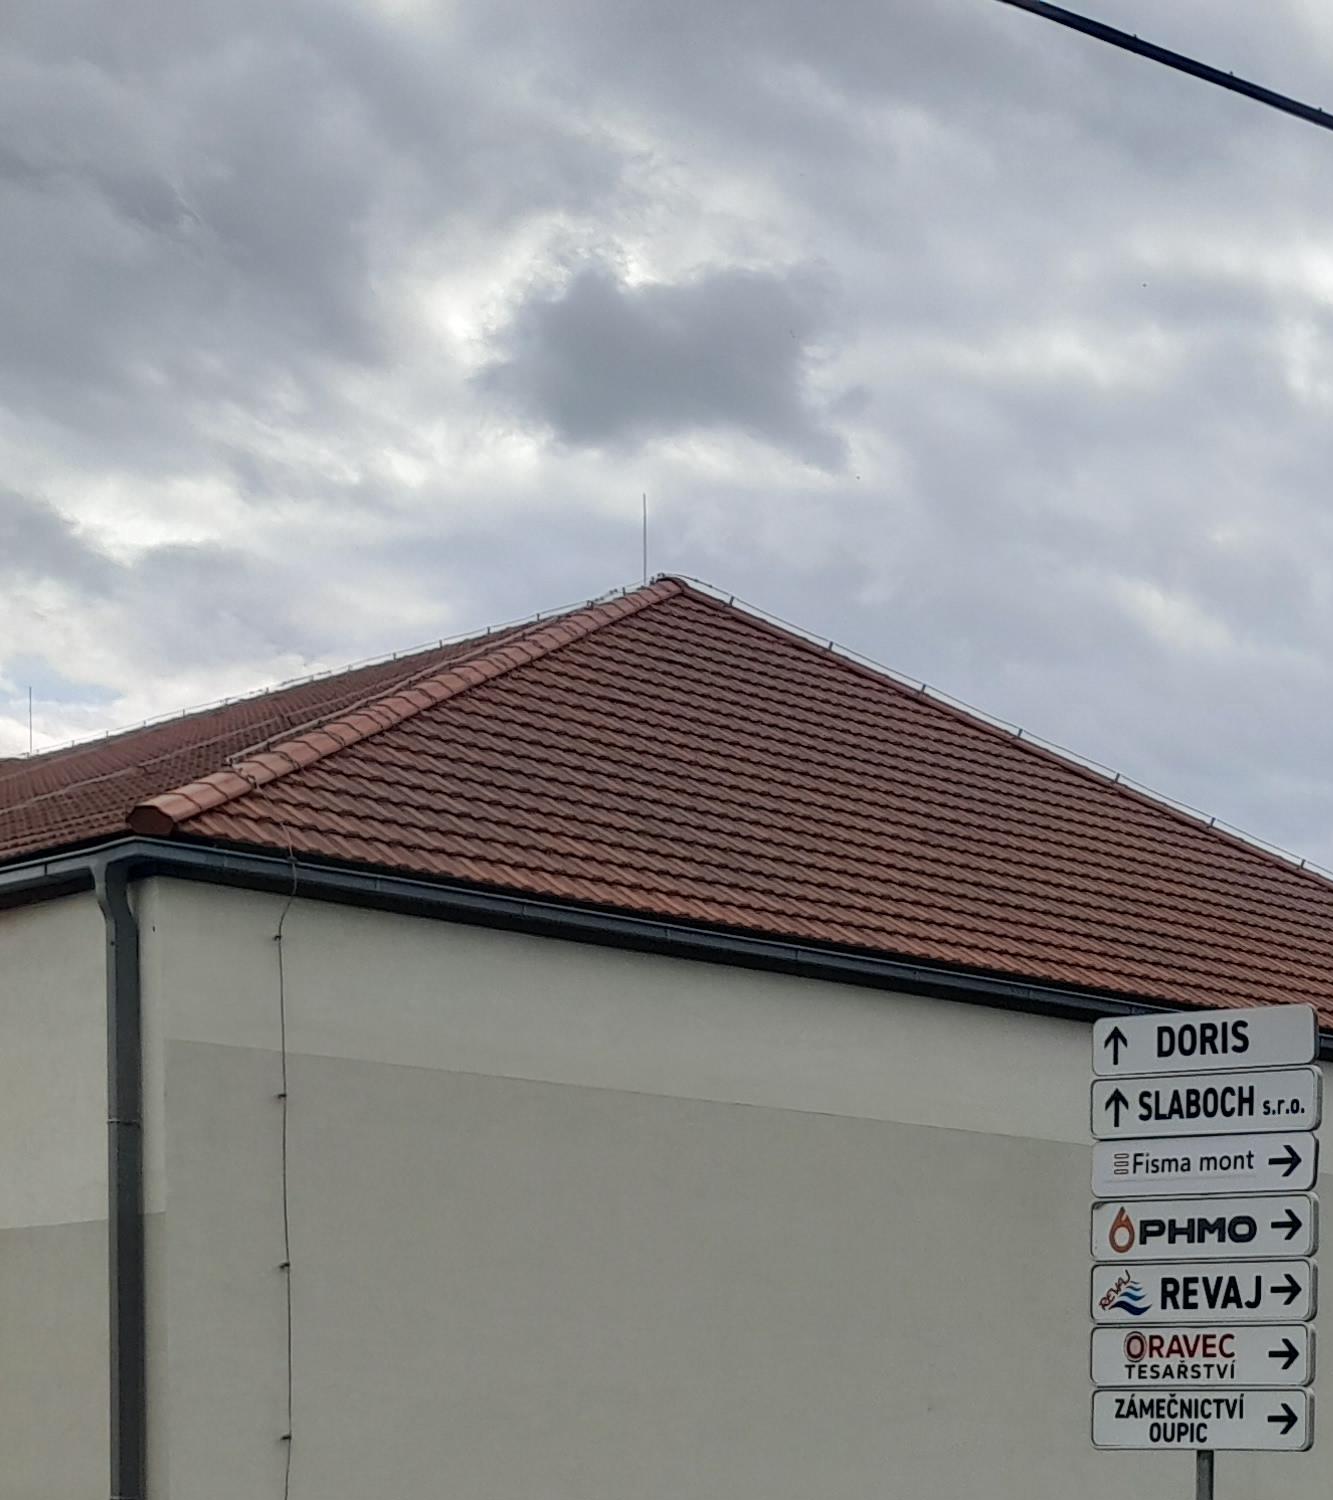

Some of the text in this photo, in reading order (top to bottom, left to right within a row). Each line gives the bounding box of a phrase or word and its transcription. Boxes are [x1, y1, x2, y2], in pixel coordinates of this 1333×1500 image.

[1157, 1020, 1249, 1058] DORIS
[1138, 1085, 1305, 1121] SLABOCH s.r.o.
[1132, 1150, 1254, 1175] Fisma mont
[1160, 1275, 1262, 1310] REVAJ
[1124, 1331, 1236, 1362] ORAVEC
[1124, 1360, 1236, 1379] TESAŘSTVÍ
[1114, 1393, 1245, 1419] ZÁMEČNICTVÍ
[1149, 1422, 1208, 1443] OUPIC
